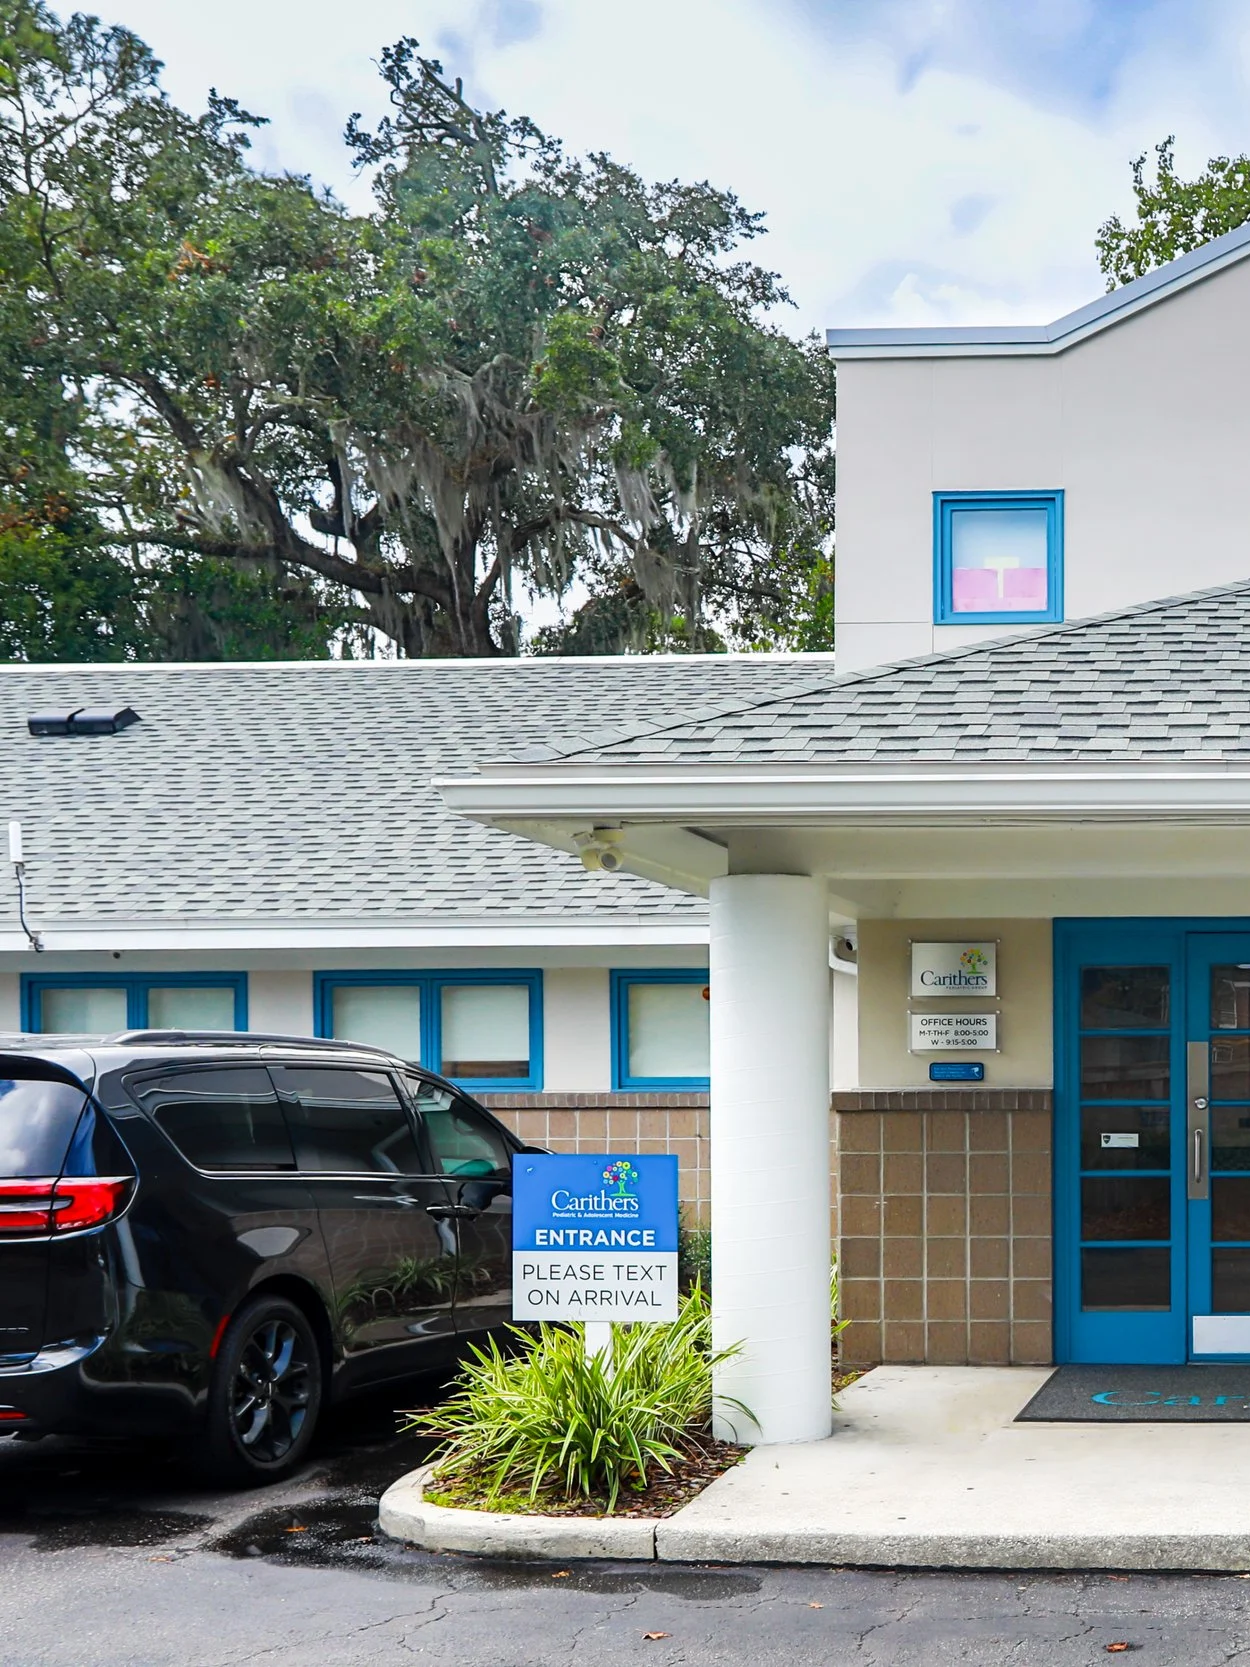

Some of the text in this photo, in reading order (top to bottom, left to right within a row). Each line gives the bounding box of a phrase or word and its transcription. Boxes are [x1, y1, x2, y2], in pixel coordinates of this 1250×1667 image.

[920, 969, 988, 986] Carithers
[920, 1018, 988, 1026] OFFICE HOURS
[551, 1189, 639, 1211] Carithers
[535, 1229, 656, 1247] ENTRANCE
[522, 1264, 667, 1281] PLEASE TEXT
[527, 1289, 662, 1306] ON ARRIVAL
